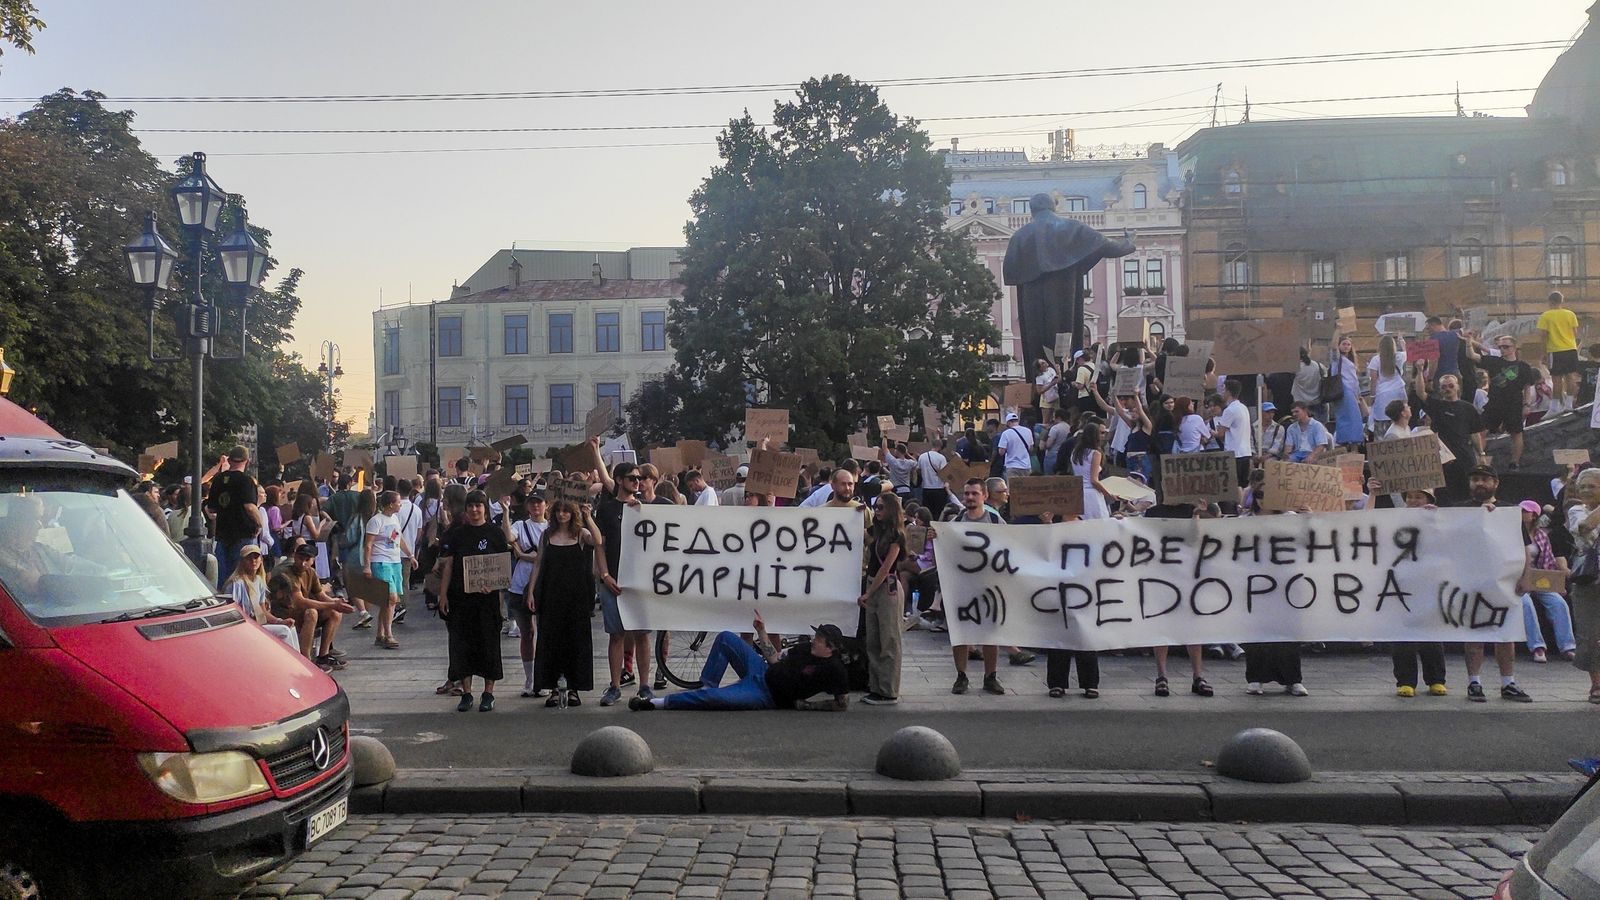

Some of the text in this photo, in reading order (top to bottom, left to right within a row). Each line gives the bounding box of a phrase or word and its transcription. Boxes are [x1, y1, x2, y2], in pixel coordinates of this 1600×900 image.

[1368, 436, 1436, 457] ПОВЕРНІТЬ
[1271, 462, 1280, 476] Я
[1285, 463, 1320, 479] БАЧУ
[1278, 478, 1292, 491] НЕ
[634, 517, 852, 555] ФЕДОРОВА
[957, 526, 1420, 578] За ПОВЕРНЕННЯ
[652, 557, 824, 600] ВИРНІТ
[311, 817, 321, 838] BC
[338, 801, 346, 819] TB
